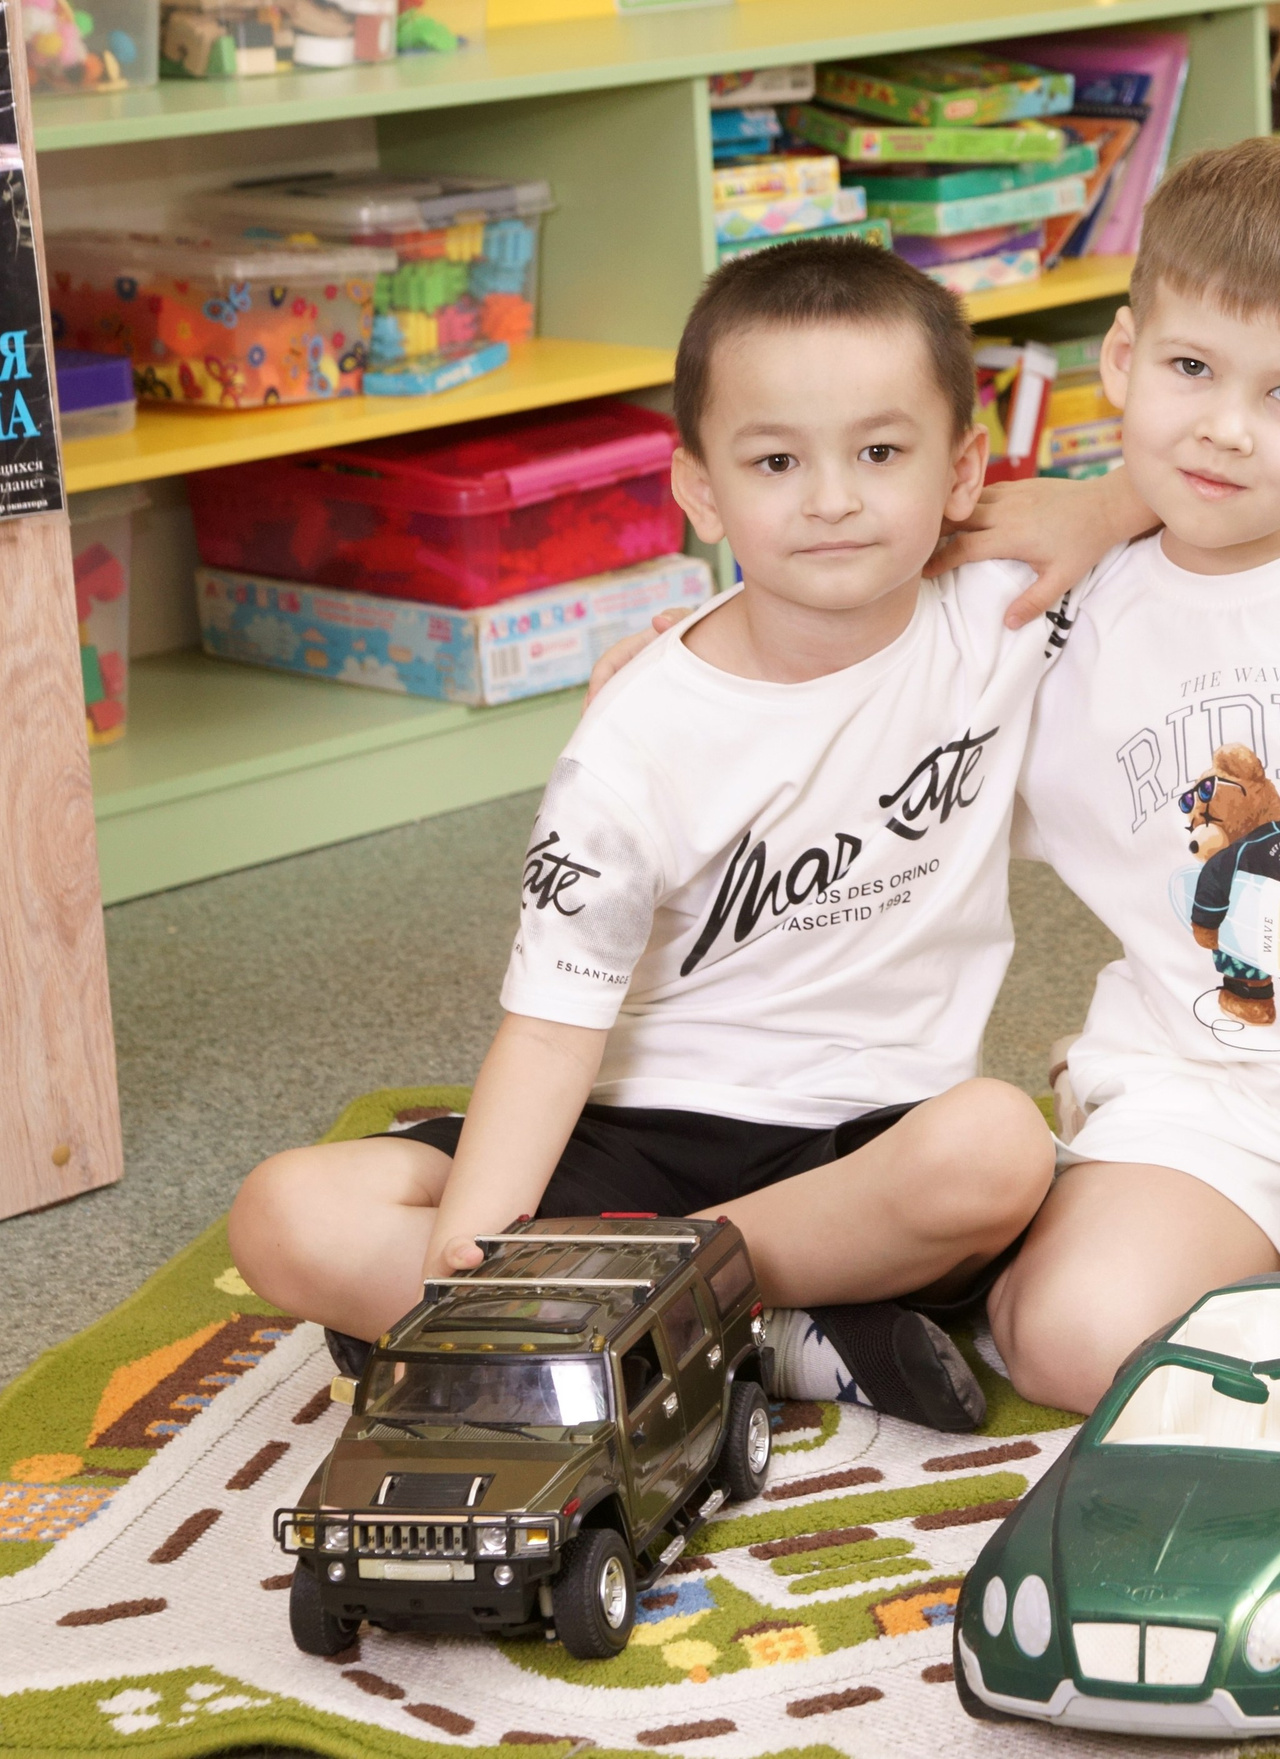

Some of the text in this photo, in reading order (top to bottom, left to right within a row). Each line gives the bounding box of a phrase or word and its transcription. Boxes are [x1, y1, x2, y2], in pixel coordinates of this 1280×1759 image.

[1180, 670, 1222, 698] THE
[847, 879, 884, 900] DES
[890, 858, 940, 889] ORINO
[878, 890, 911, 914] 1992
[1263, 917, 1274, 953] WAVE
[368, 1535, 461, 1545] HUMMER
